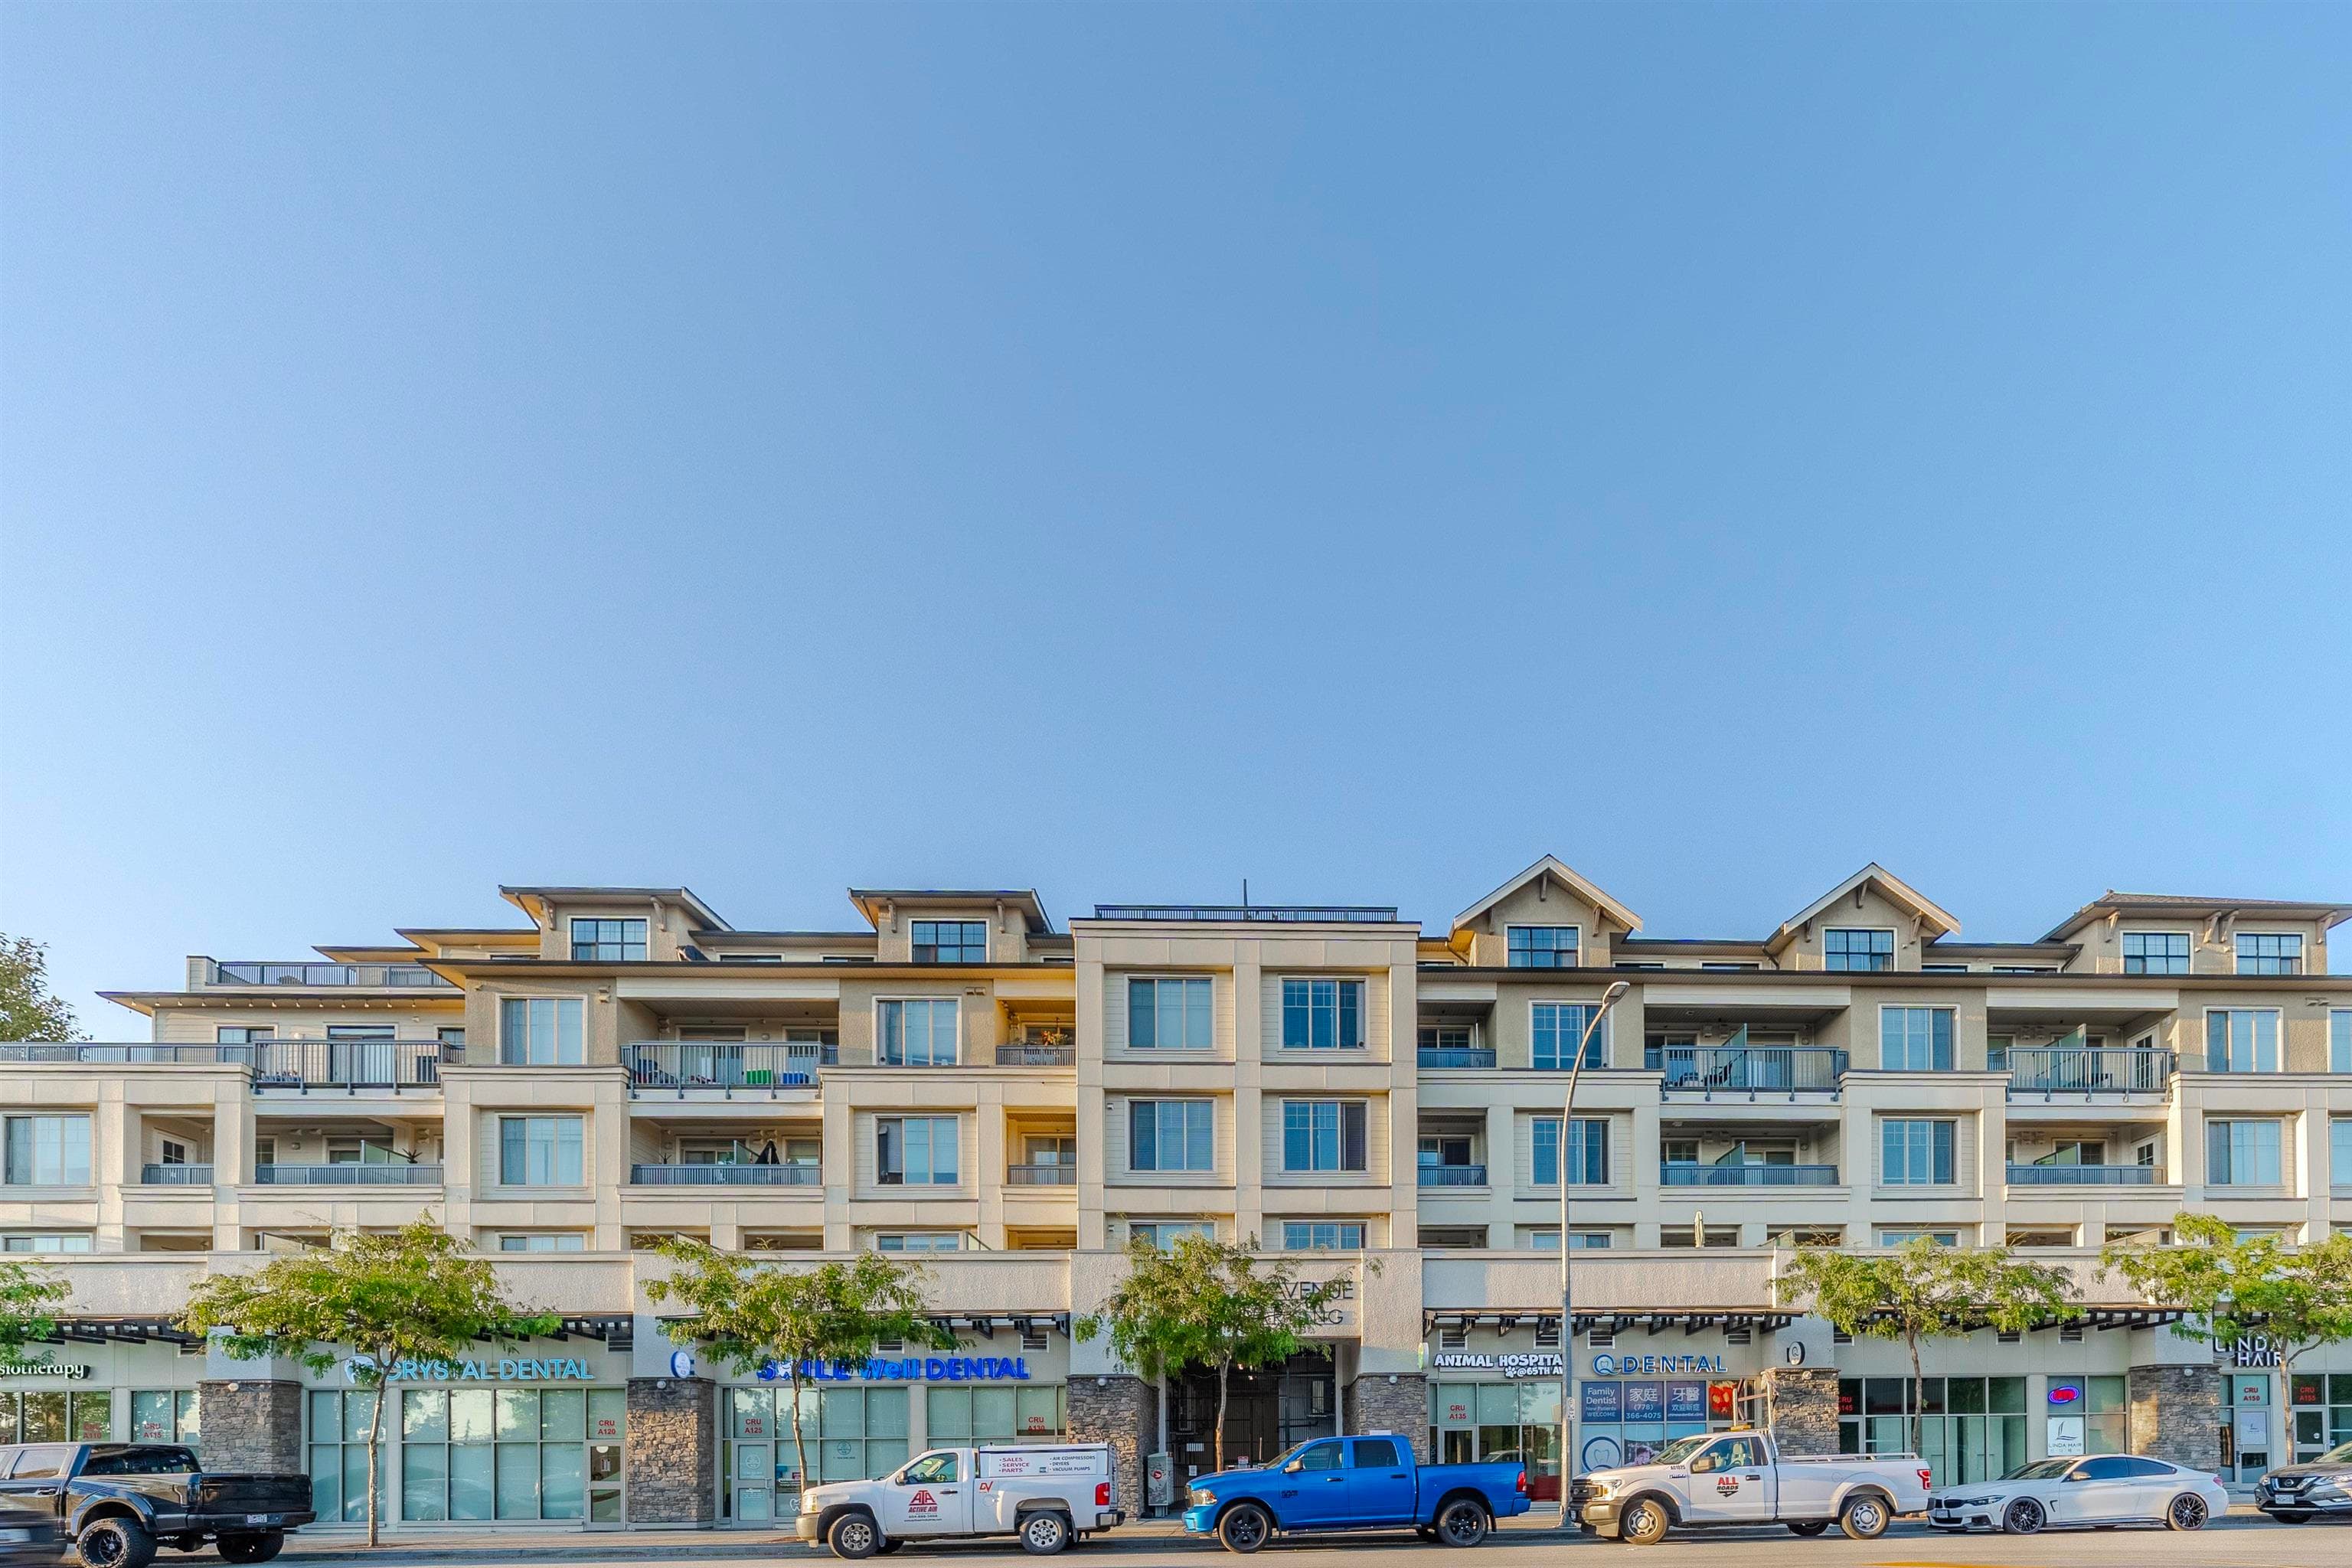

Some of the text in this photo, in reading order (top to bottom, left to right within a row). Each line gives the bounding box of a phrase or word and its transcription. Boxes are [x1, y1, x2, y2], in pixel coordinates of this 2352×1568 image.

[1434, 1353, 1563, 1367] ANIMAL HOSPITA
[1592, 1354, 1728, 1376] Q DENTAL
[2237, 1351, 2282, 1367] HAIR
[499, 1358, 595, 1380] DENTAL
[860, 1357, 920, 1380] Well
[925, 1357, 1030, 1380] DENTAL
[1517, 1367, 1563, 1377] @65TH AV
[1587, 1387, 1615, 1397] Family
[1629, 1387, 1658, 1402] 家庭
[1672, 1387, 1700, 1402] 牙醫
[1717, 1476, 1739, 1485] ALL
